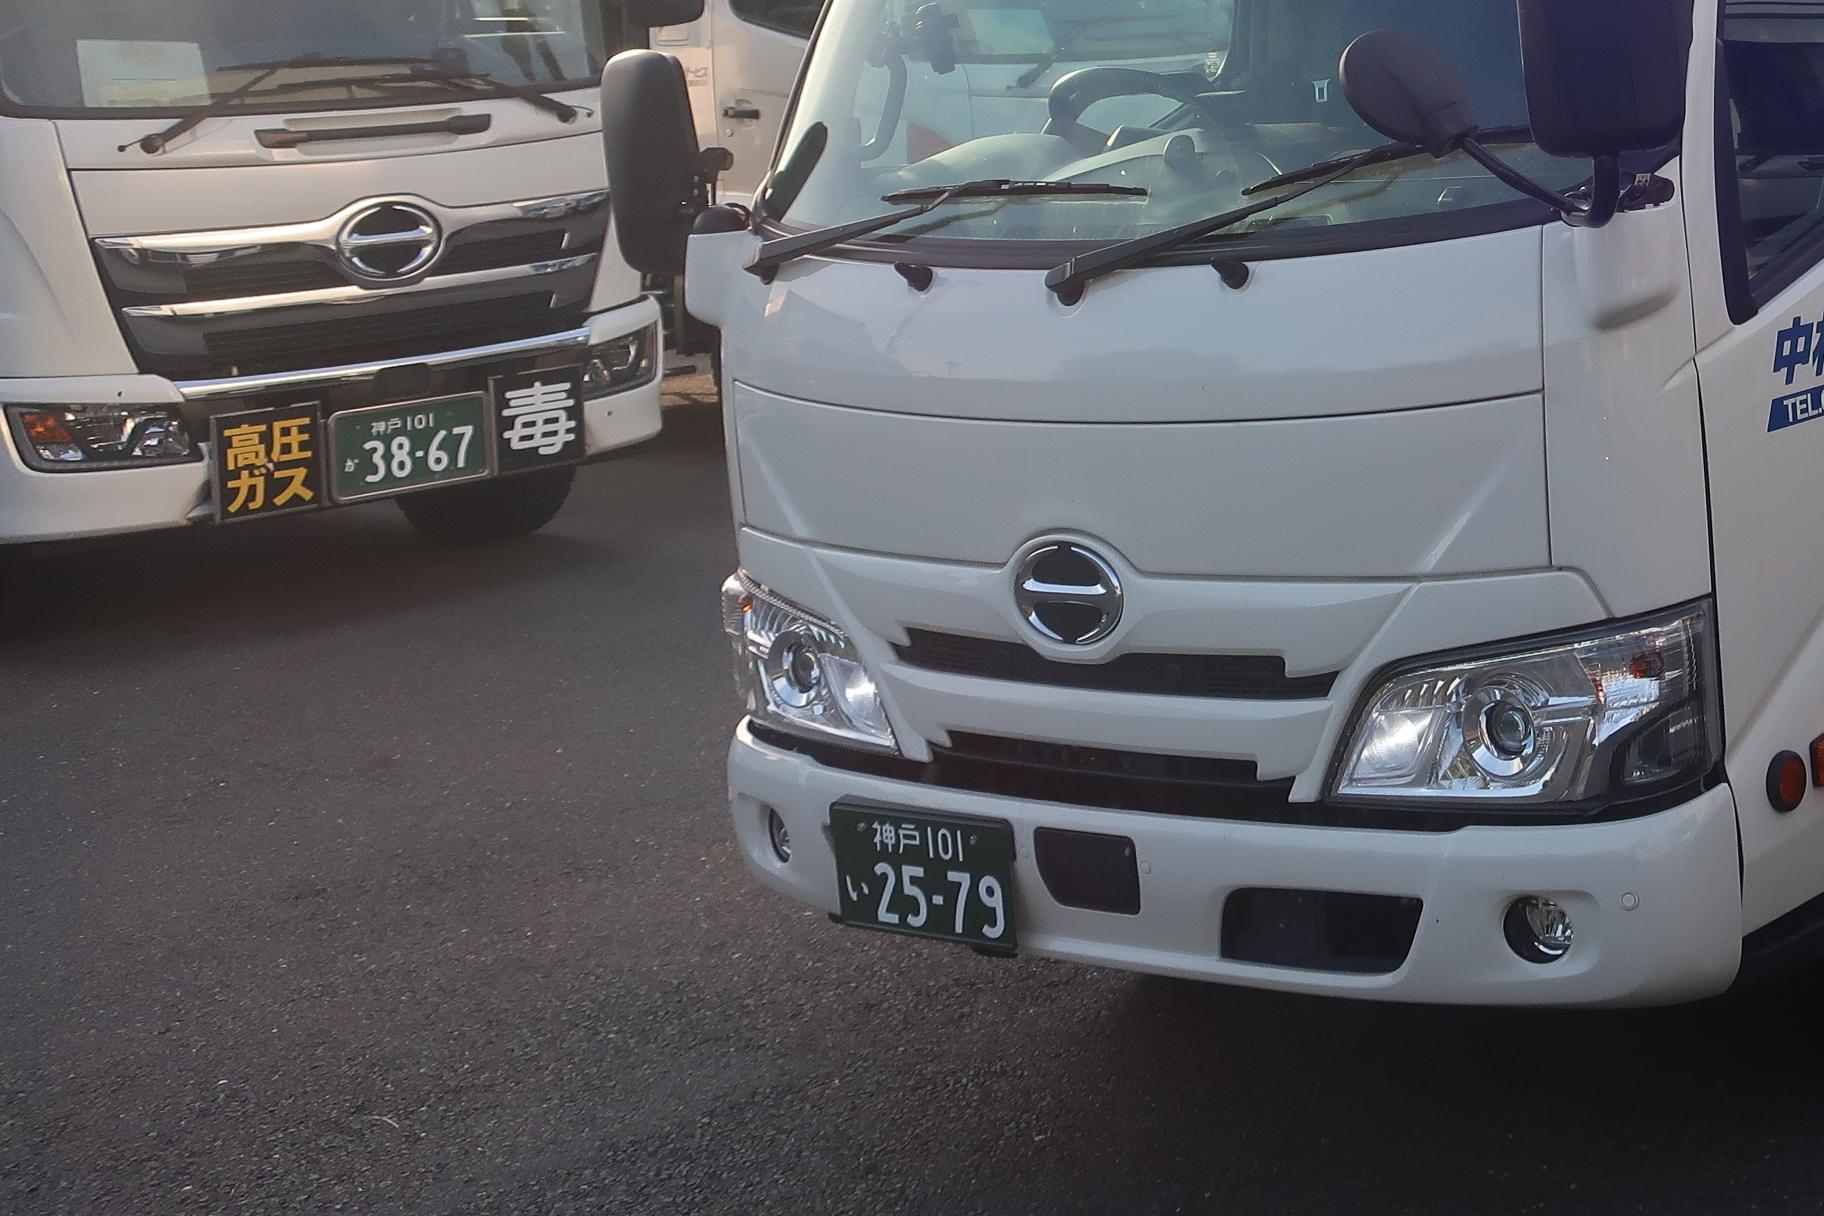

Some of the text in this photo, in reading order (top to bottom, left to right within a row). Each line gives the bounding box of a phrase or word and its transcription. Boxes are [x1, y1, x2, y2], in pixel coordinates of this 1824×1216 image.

[223, 417, 313, 470] 高圧
[501, 381, 576, 456] 毒
[362, 424, 474, 484] 38-67
[226, 462, 314, 513] ガス
[846, 862, 1006, 940] い 25-79
